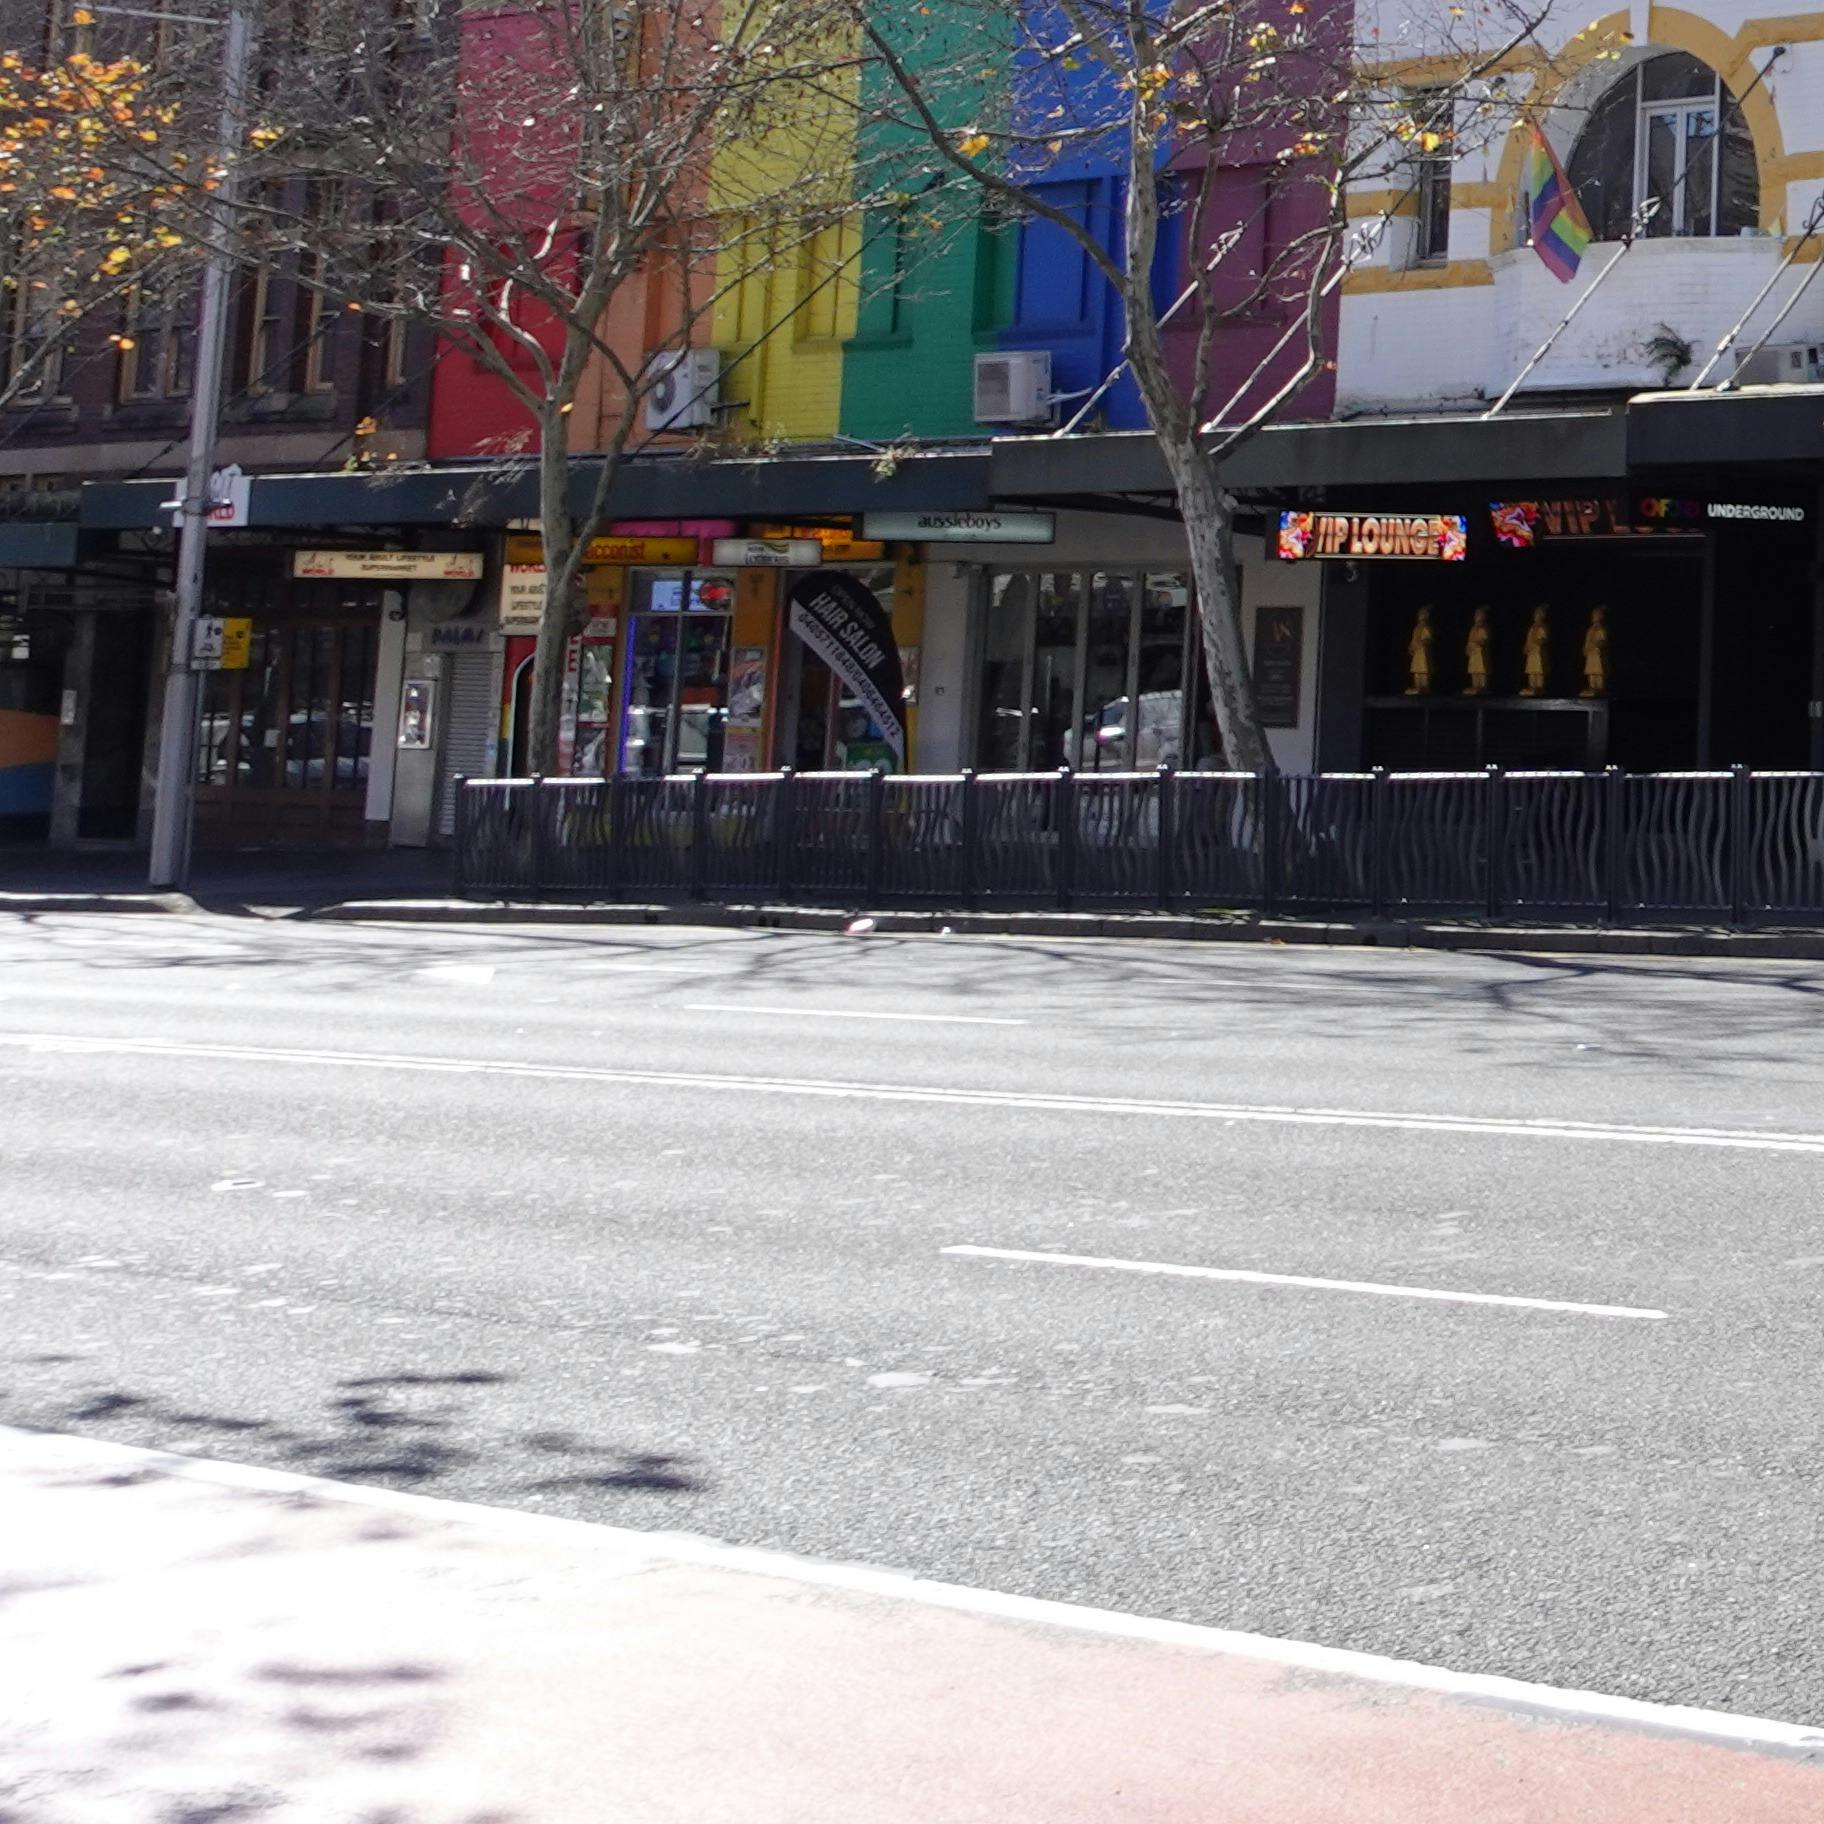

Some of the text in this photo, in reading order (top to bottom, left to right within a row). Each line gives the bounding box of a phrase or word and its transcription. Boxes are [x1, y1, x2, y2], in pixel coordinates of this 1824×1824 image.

[918, 513, 1001, 531] aussieboys
[1544, 500, 1599, 534] VIP
[1708, 502, 1804, 521] UNDERGROUND
[1351, 517, 1440, 555] LOUNGE
[809, 592, 886, 670] HAIR SALON
